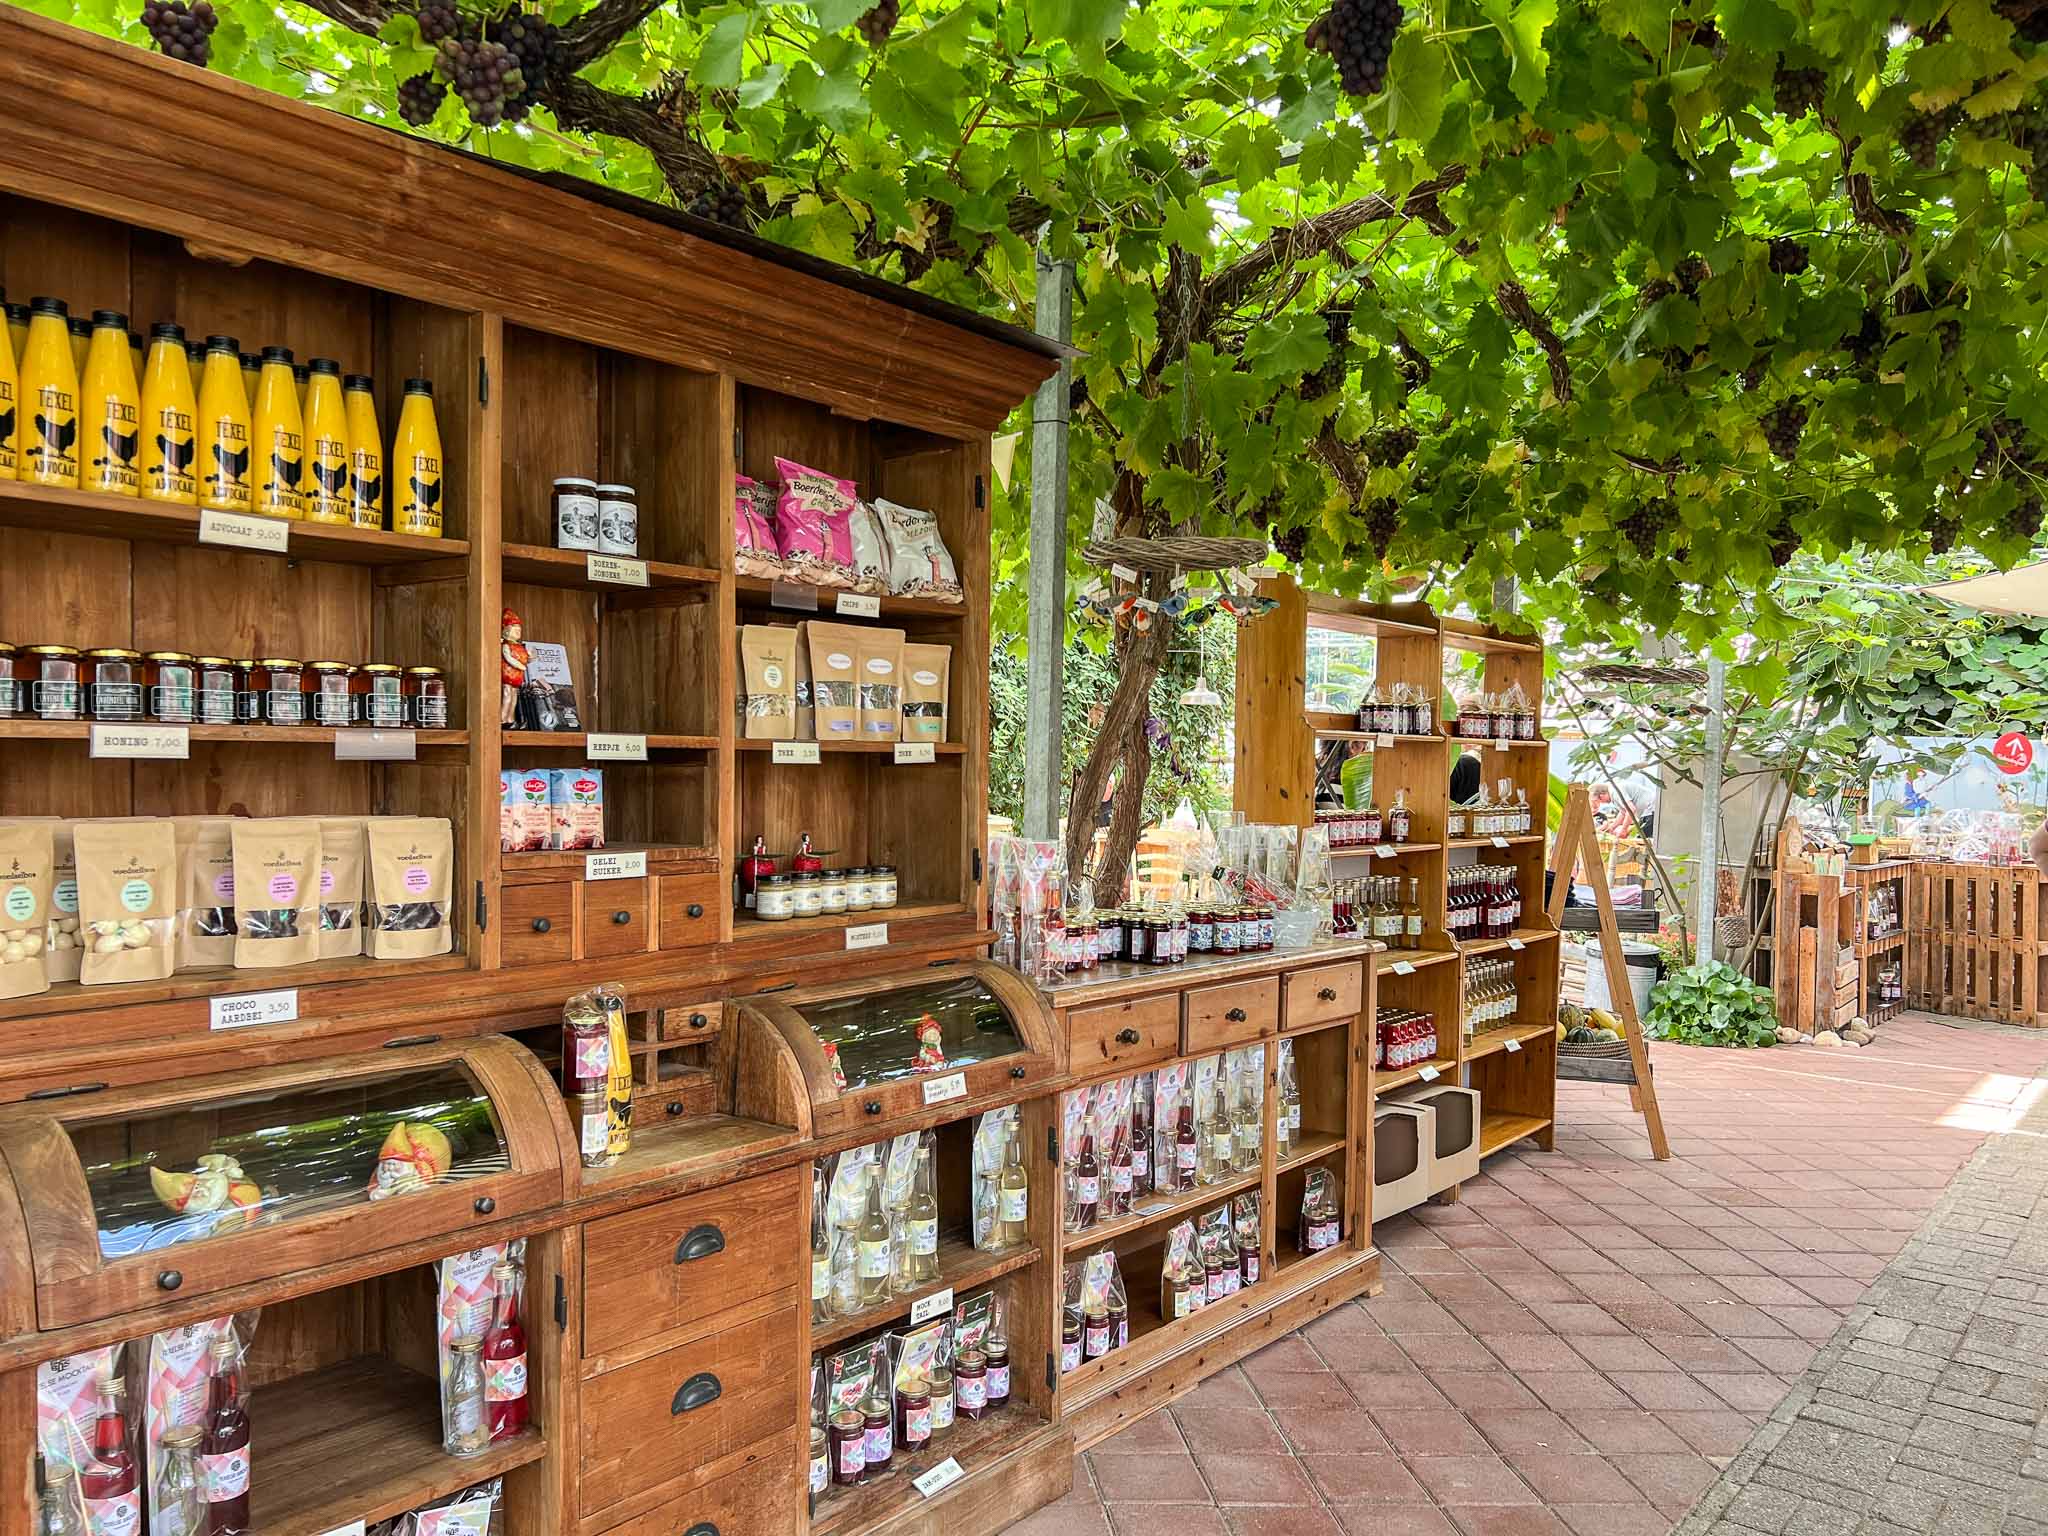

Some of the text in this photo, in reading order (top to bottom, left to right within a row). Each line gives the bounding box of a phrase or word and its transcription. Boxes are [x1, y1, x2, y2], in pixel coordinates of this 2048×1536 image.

[37, 389, 73, 413] TEXEL
[105, 402, 137, 423] TEXEL
[160, 411, 192, 432] TEXEL
[216, 421, 247, 442] TEXEL
[315, 439, 345, 458] TEXEL
[352, 452, 379, 471] TEXEL
[412, 456, 439, 474] TEXEL
[209, 522, 252, 537] ADVOCAAT
[593, 559, 621, 569] BOEREN-
[104, 736, 149, 747] HONING
[592, 743, 621, 752] REEPJE
[592, 857, 617, 866] GELEI
[592, 867, 622, 876] SUIKER
[221, 1000, 257, 1012] CHOCO
[221, 1011, 263, 1025] AARDBEI
[916, 1300, 931, 1312] MOCK
